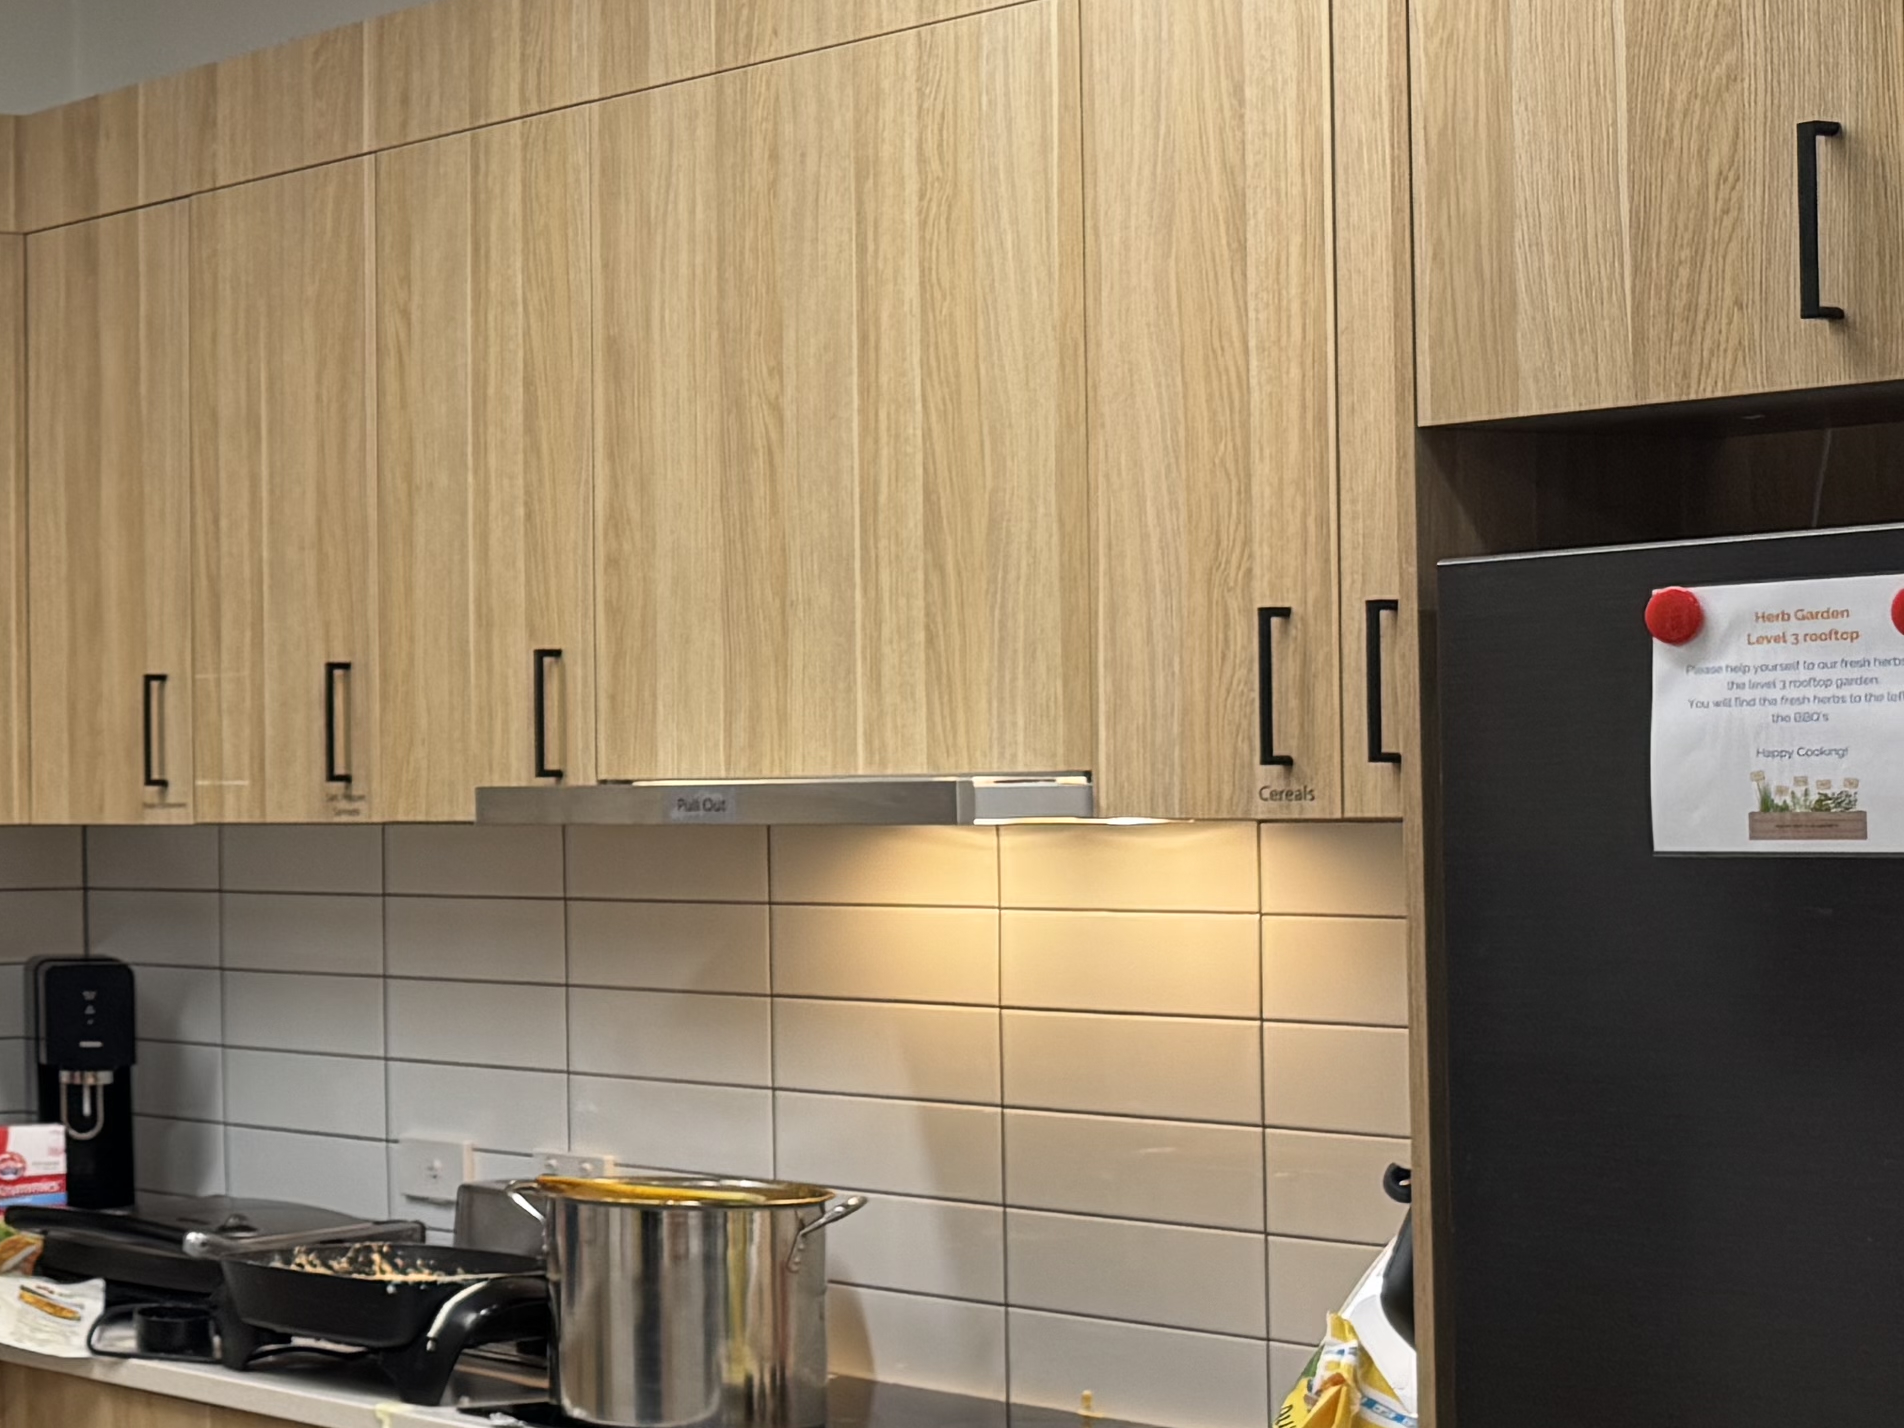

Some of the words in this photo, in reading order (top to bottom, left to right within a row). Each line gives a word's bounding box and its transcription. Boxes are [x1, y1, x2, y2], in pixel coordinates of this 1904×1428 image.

[1754, 610, 1791, 623] Herb
[1794, 608, 1850, 621] Garden
[1747, 632, 1786, 646] Level
[1791, 634, 1799, 645] 3
[1803, 629, 1860, 644] rooftop
[1725, 663, 1751, 675] help
[1835, 676, 1879, 690] garden
[1756, 748, 1793, 759] Happy
[1258, 785, 1316, 802] Cereals
